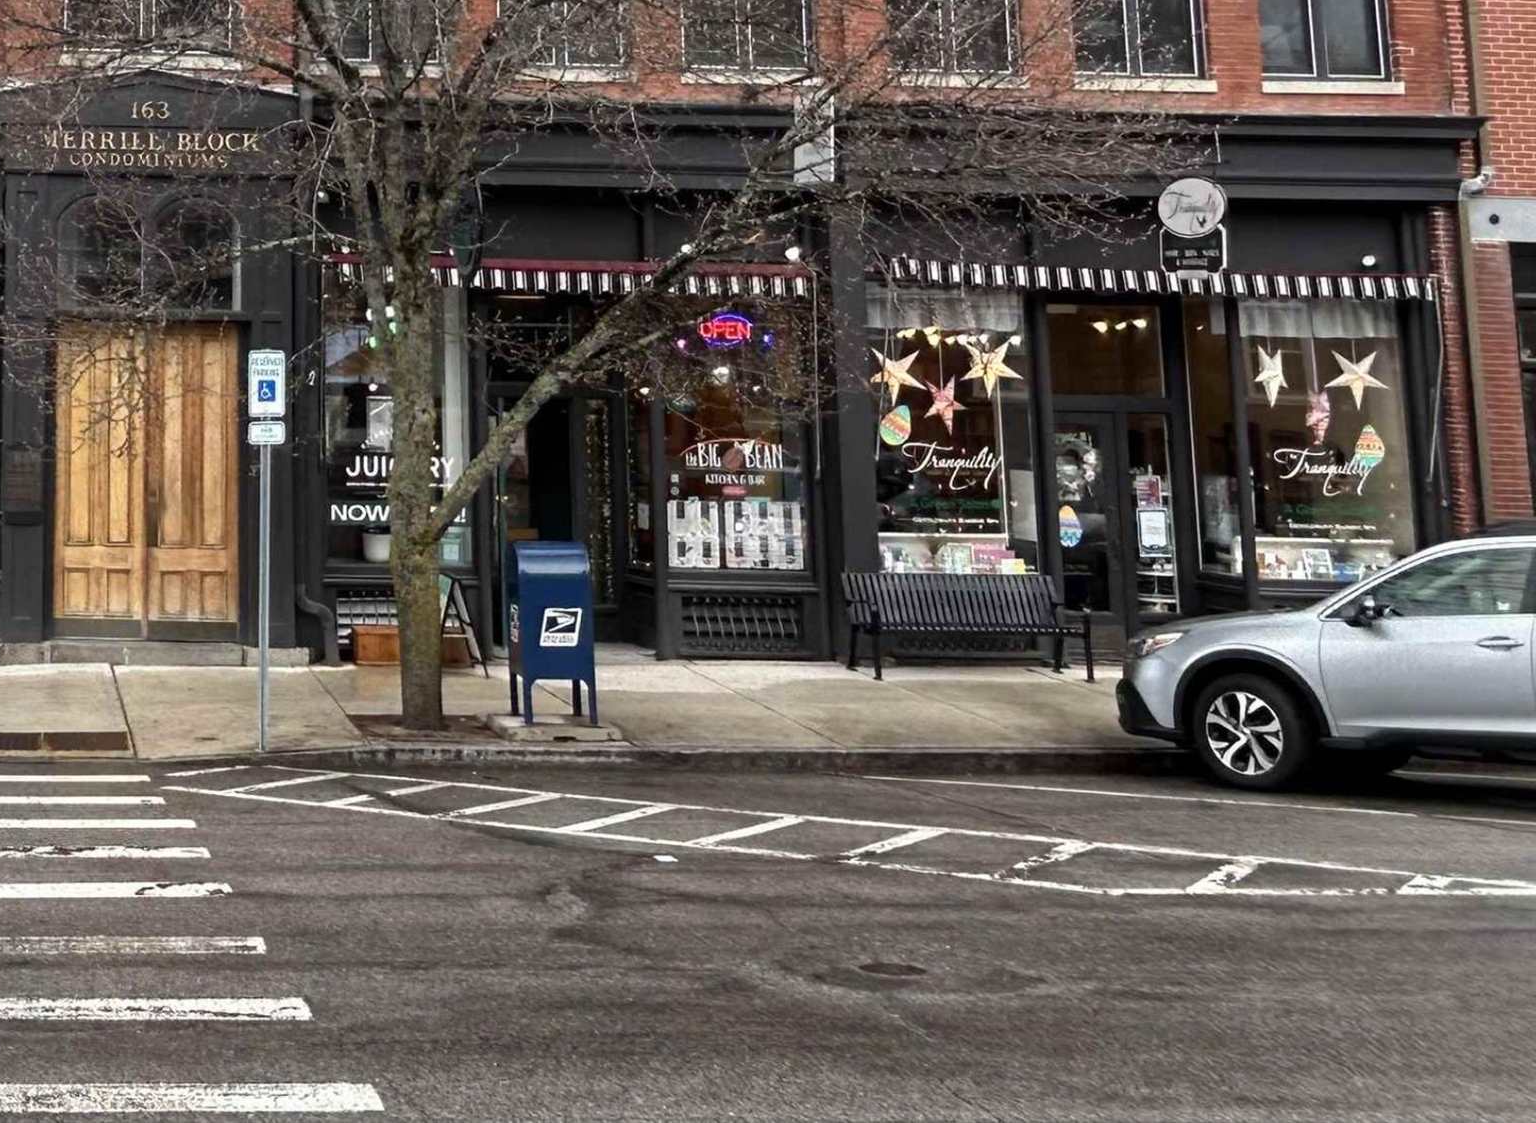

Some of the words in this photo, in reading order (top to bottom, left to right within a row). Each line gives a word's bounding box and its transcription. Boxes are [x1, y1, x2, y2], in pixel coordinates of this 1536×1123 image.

[131, 101, 170, 119] 163
[43, 130, 164, 151] MERRILL
[177, 132, 260, 153] BLOCK
[69, 152, 229, 168] CONDOMINIUMS
[699, 322, 752, 340] OPEN
[345, 455, 455, 478] JUIRY
[697, 443, 721, 467] BIG
[744, 443, 784, 470] BEAN
[901, 441, 1002, 491] Tranquility
[1273, 448, 1377, 496] Tranquility
[330, 504, 391, 522] NOW
